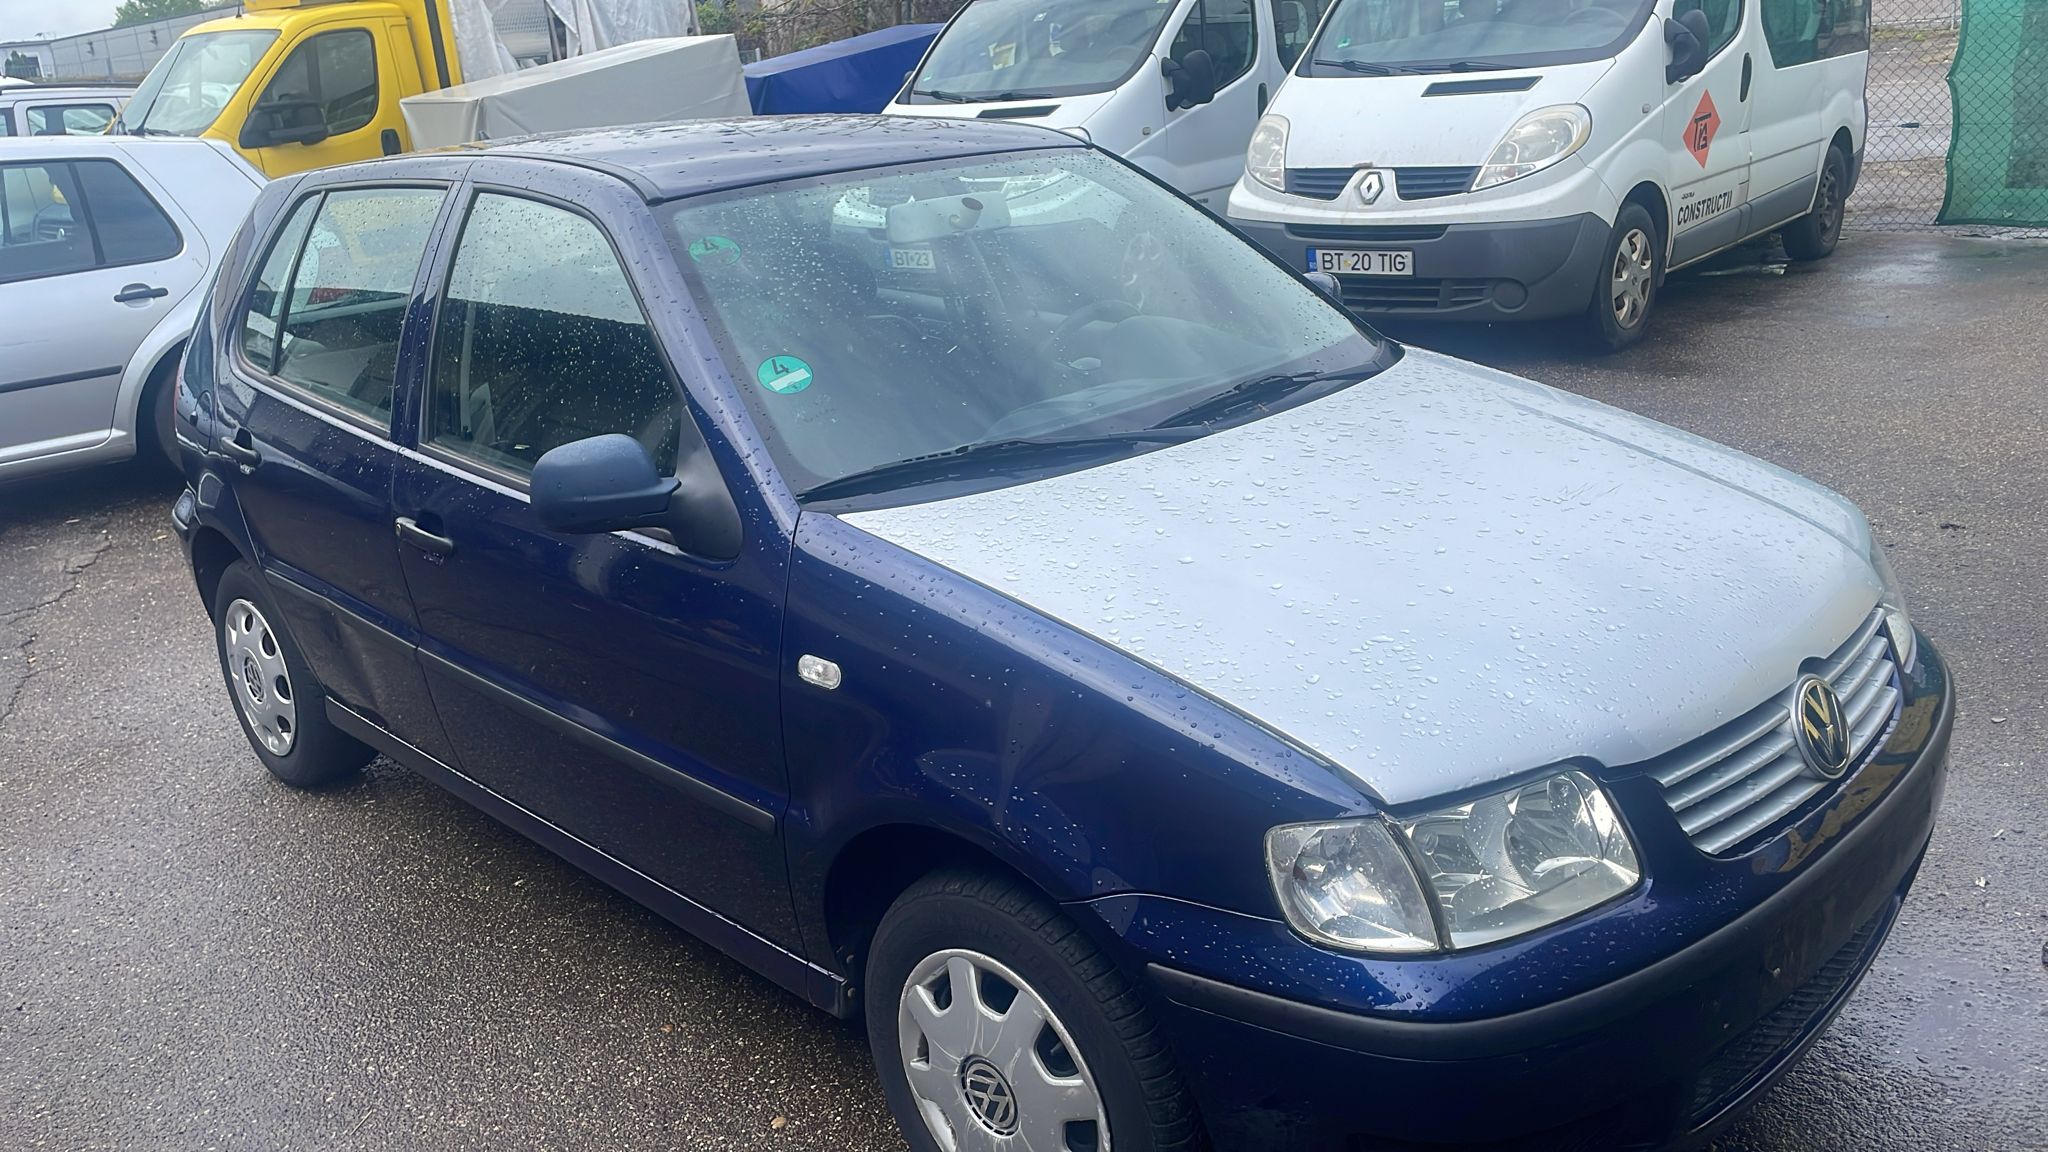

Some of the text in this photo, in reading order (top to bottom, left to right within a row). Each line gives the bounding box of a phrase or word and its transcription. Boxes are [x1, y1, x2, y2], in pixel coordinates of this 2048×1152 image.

[1677, 190, 1733, 226] CONSTRUCTII
[895, 251, 929, 267] BT 23
[1322, 252, 1406, 272] BT 20 TIG
[771, 358, 791, 375] 4
